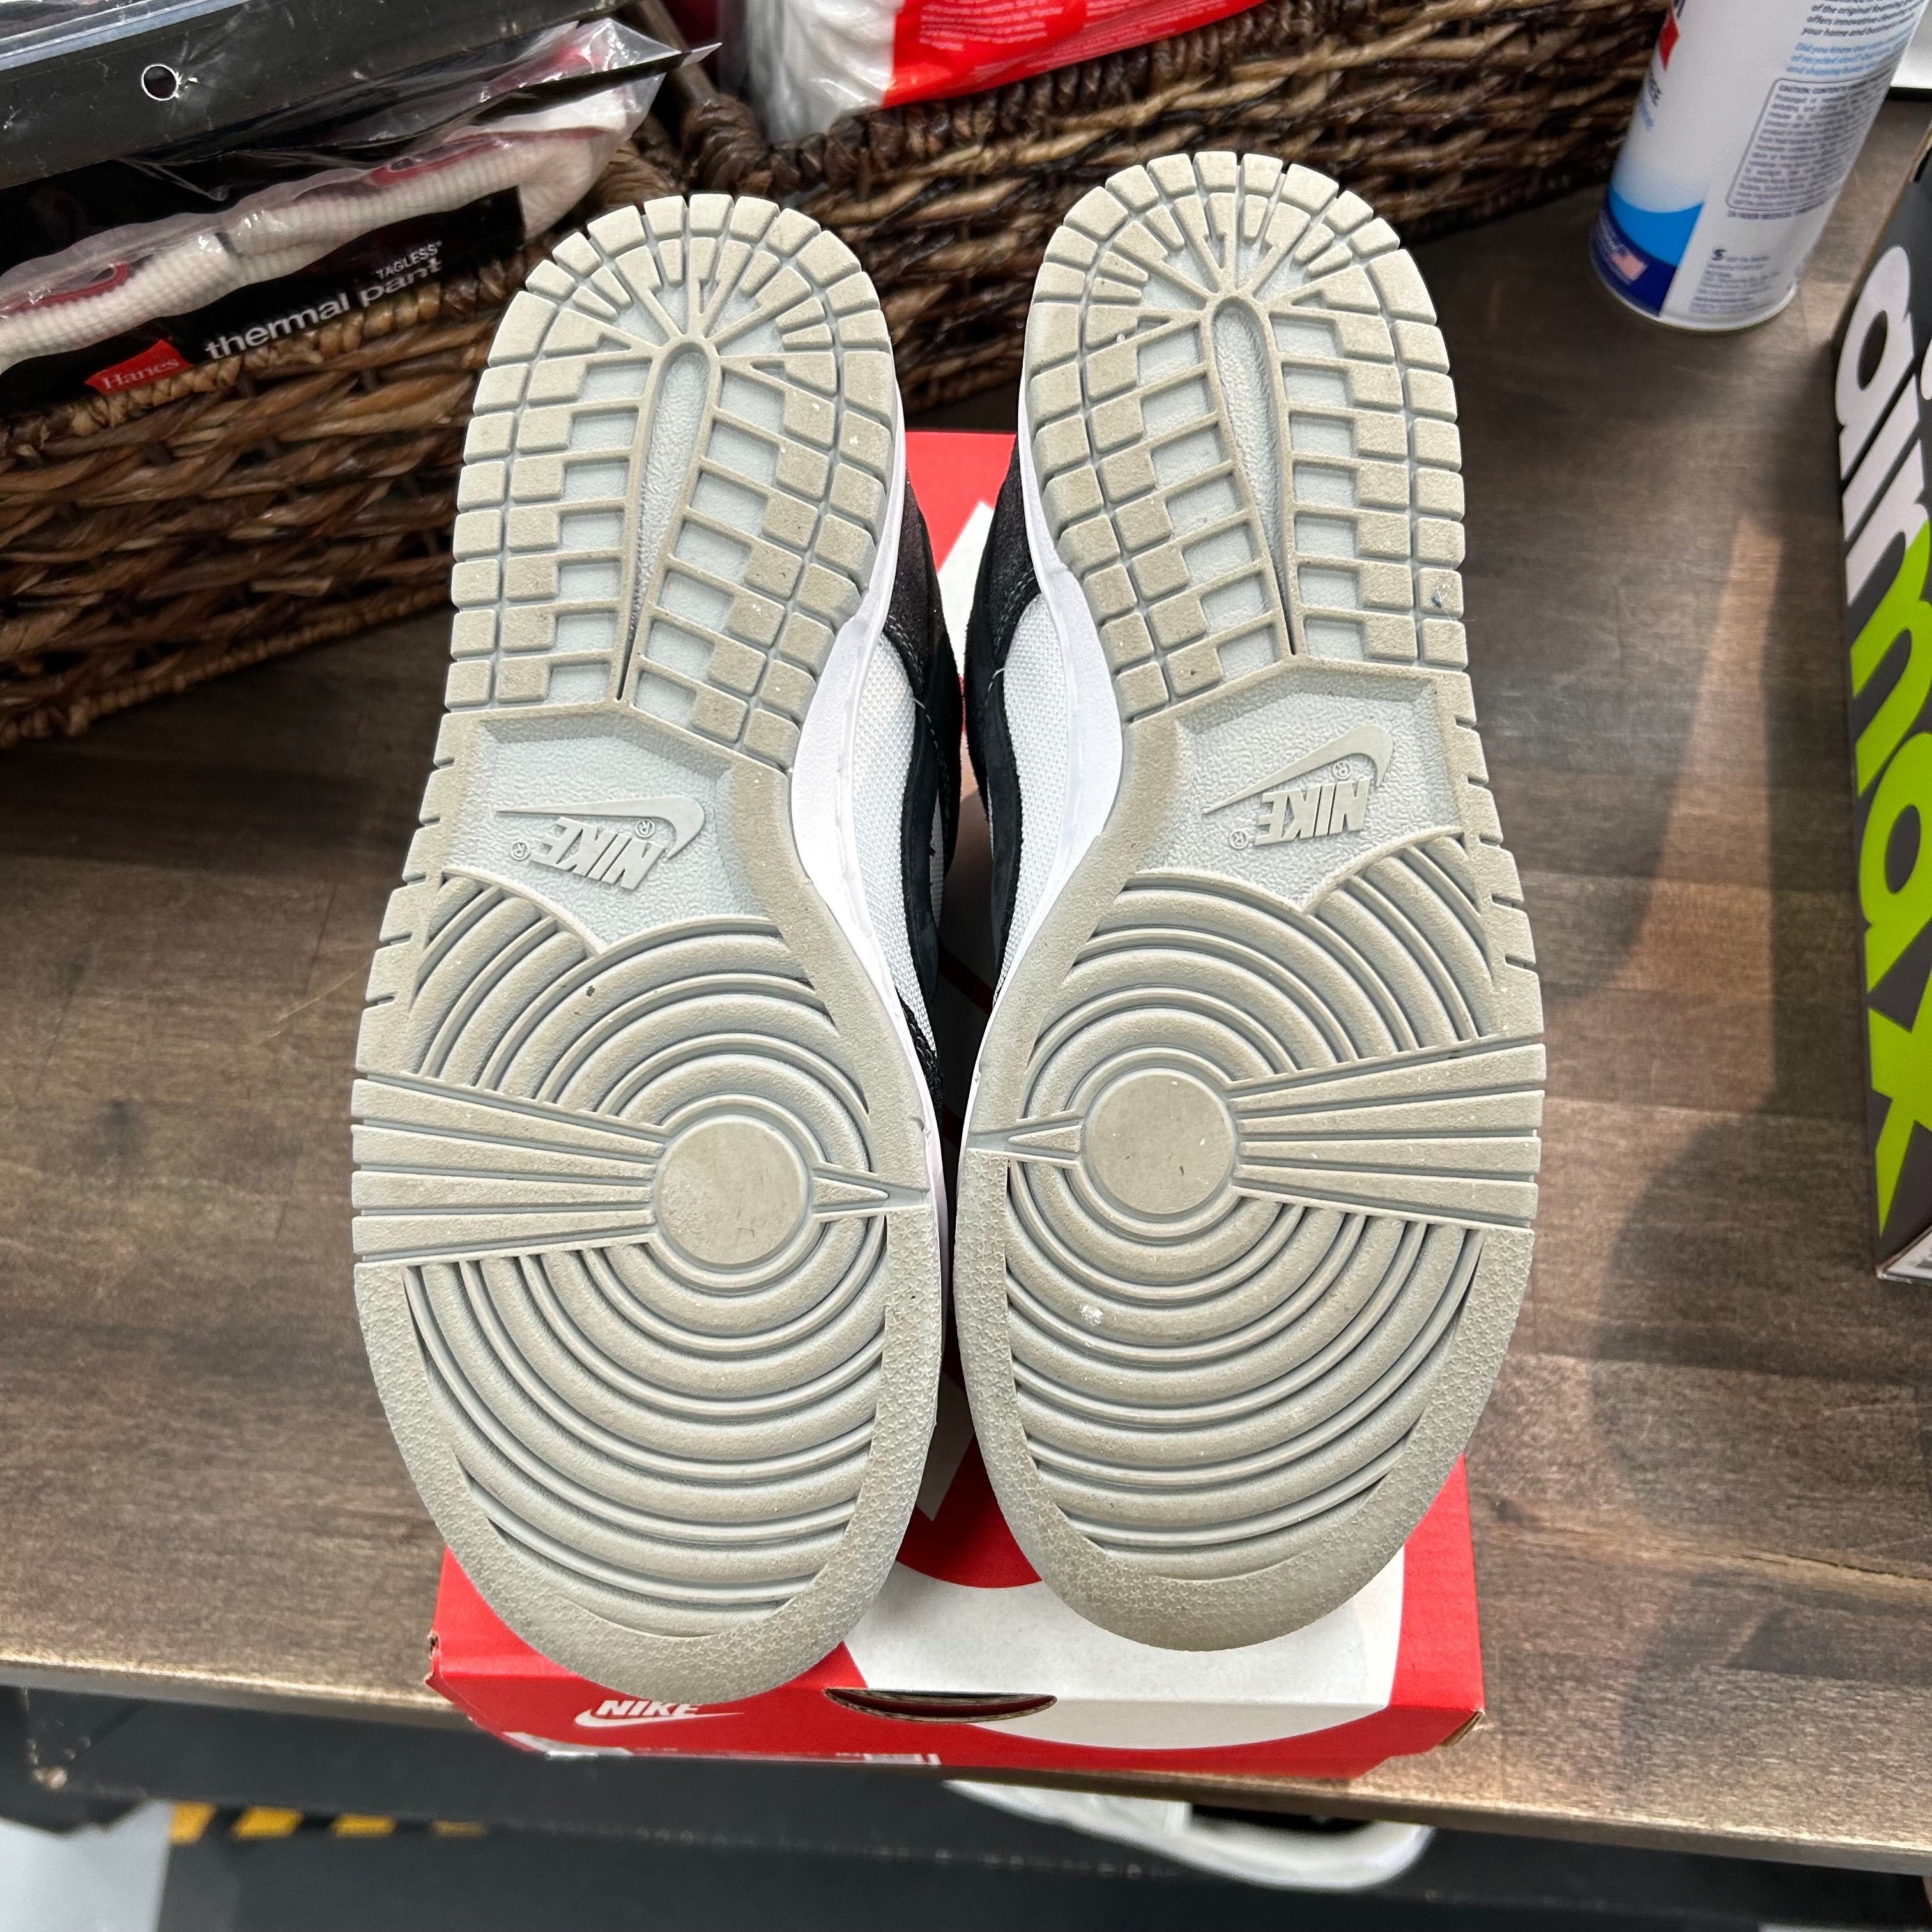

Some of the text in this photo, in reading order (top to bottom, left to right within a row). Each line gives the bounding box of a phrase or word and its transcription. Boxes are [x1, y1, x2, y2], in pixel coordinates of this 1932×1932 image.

[374, 242, 440, 279] TAGLESS
[206, 257, 442, 360] thermal pant
[102, 358, 180, 389] Hanes
[1253, 777, 1370, 847] NIKE
[529, 816, 666, 890] NIKE
[595, 1699, 699, 1717] NIKE
